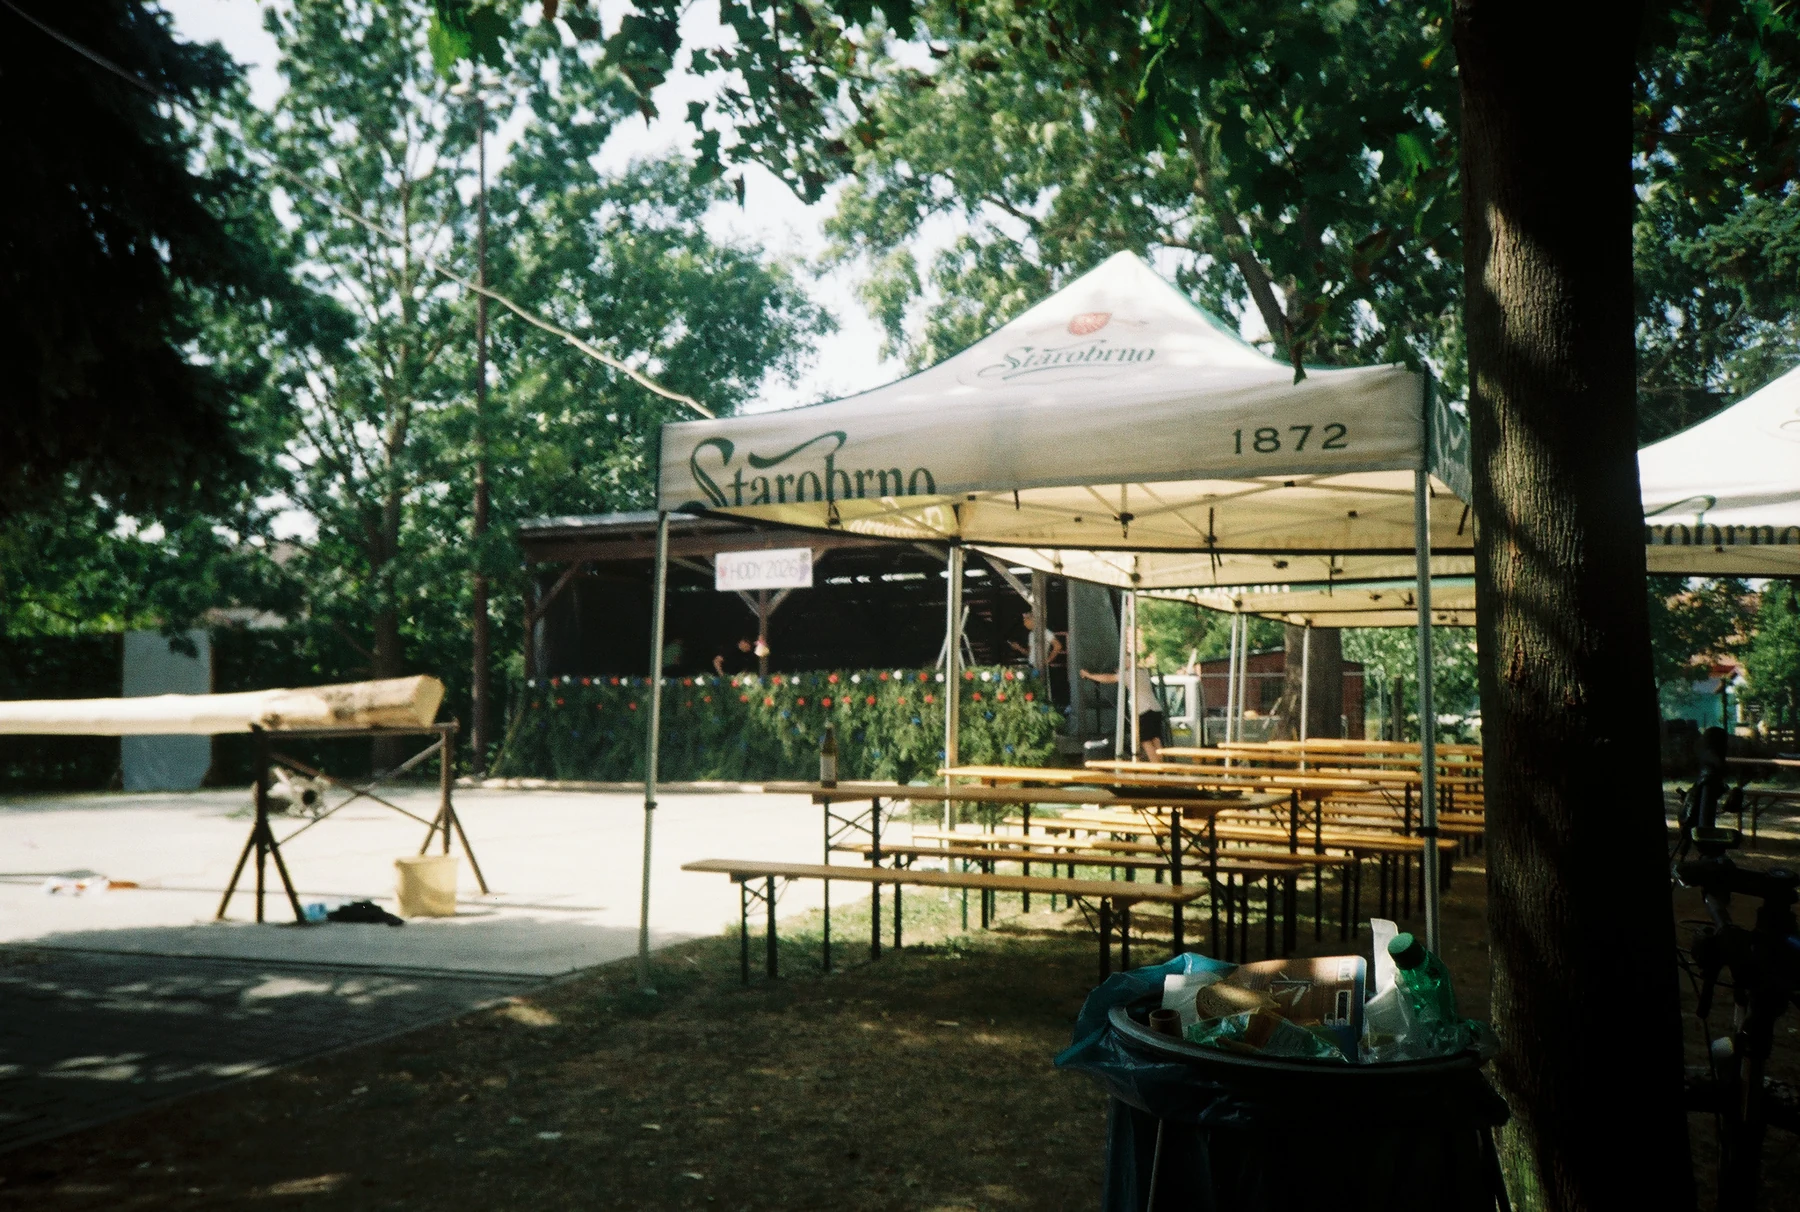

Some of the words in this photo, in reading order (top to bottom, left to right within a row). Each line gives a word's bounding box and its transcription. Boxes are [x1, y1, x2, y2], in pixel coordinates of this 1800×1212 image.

[978, 339, 1155, 378] Starobrno
[1232, 422, 1349, 455] 1872
[690, 430, 937, 507] Starobrno
